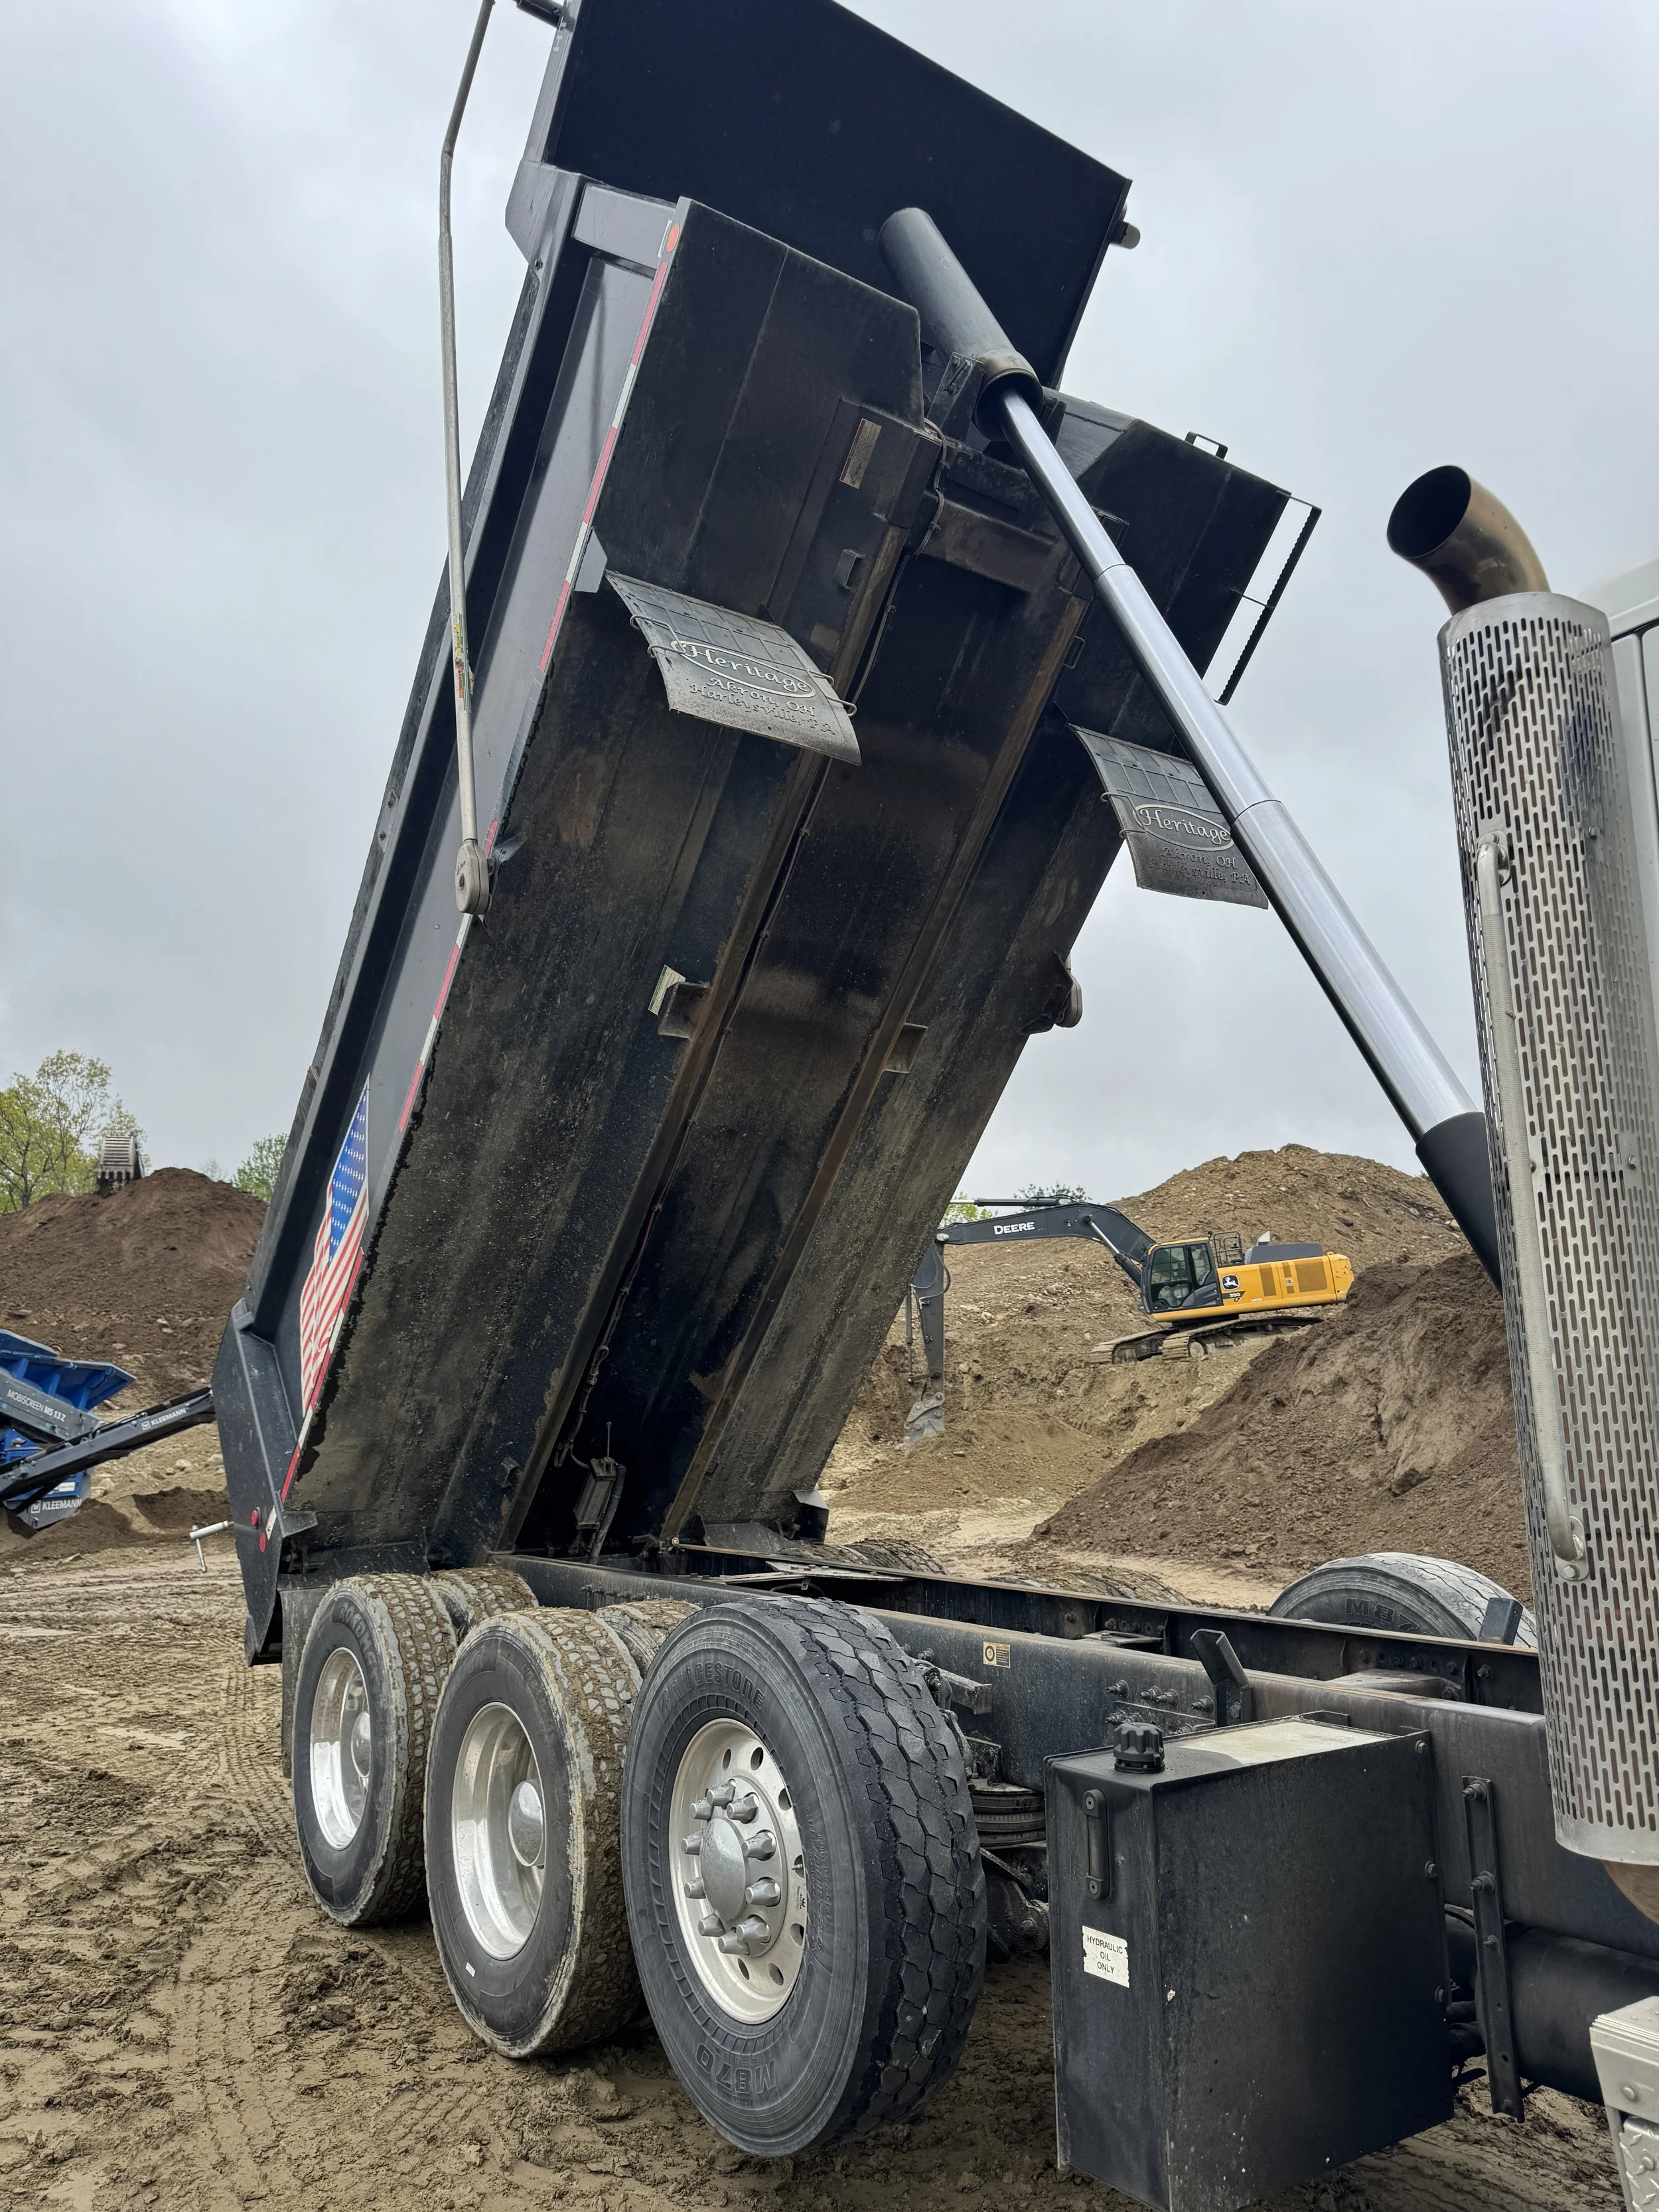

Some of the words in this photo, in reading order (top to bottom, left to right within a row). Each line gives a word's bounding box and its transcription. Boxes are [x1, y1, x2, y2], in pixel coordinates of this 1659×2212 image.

[682, 642, 810, 693] Heritage
[707, 678, 779, 707] Akron,
[786, 700, 816, 717] OH
[1139, 809, 1230, 845] Heritage
[1161, 847, 1210, 865] Akron,
[1215, 855, 1236, 869] OH
[1230, 872, 1251, 885] PA
[993, 1221, 1035, 1235] DEERE
[7, 1389, 44, 1412] MOBISCREEN
[43, 1406, 54, 1416] MS
[53, 1410, 62, 1420] 13
[60, 1413, 66, 1422] Z
[151, 1407, 187, 1427] KLEEMANN
[42, 1498, 83, 1511] KLEEMANN
[1345, 1597, 1429, 1636] M87
[1087, 1935, 1123, 1954] HYDRAULIC
[1100, 1951, 1111, 1961] OIL
[1097, 1961, 1115, 1974] ONLY
[695, 2043, 776, 2095] M870
